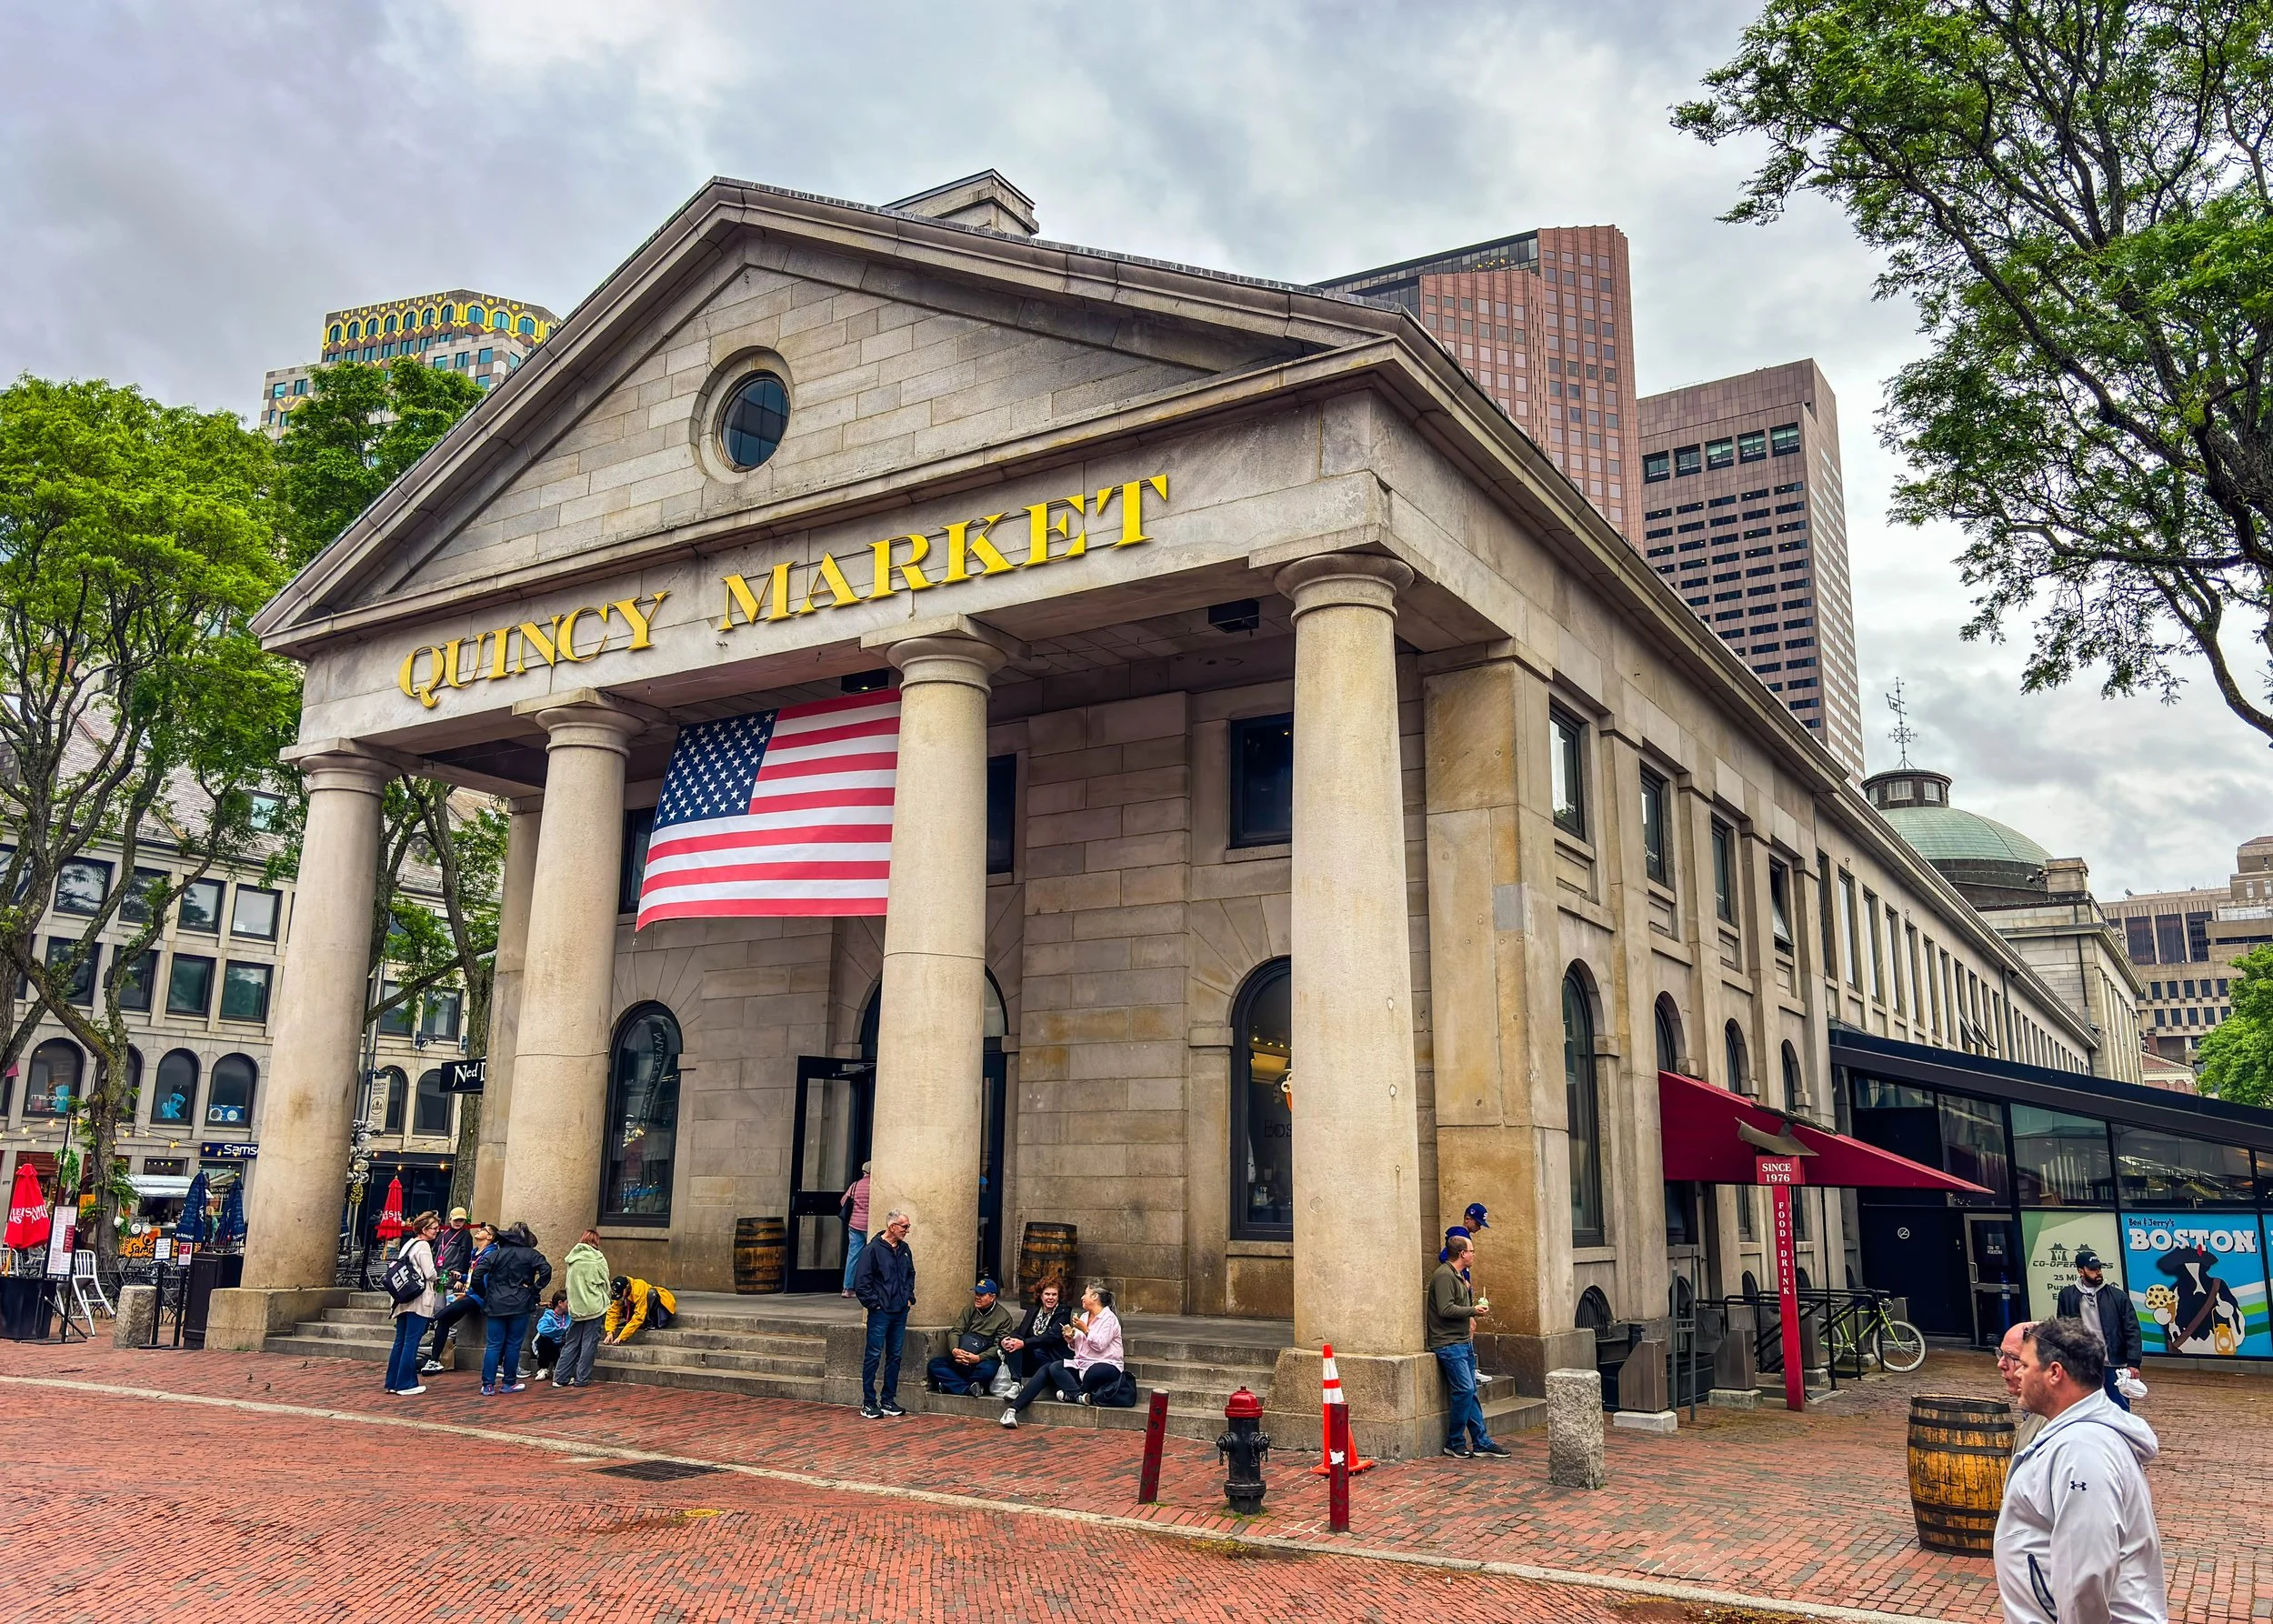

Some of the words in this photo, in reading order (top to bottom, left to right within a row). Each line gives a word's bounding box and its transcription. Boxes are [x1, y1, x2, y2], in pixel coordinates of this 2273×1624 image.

[398, 591, 671, 708] QUINCY
[717, 474, 1168, 631] MARKET
[453, 1063, 478, 1088] Ned
[223, 1144, 258, 1156] Sams
[1762, 1163, 1792, 1172] SINCE
[1766, 1174, 1790, 1182] 1976
[1778, 1202, 1787, 1237] FOOD
[2128, 1218, 2142, 1227] Ben
[2148, 1218, 2175, 1229] Jerry's
[2128, 1228, 2258, 1253] BOSTON
[1780, 1250, 1789, 1295] DRINK
